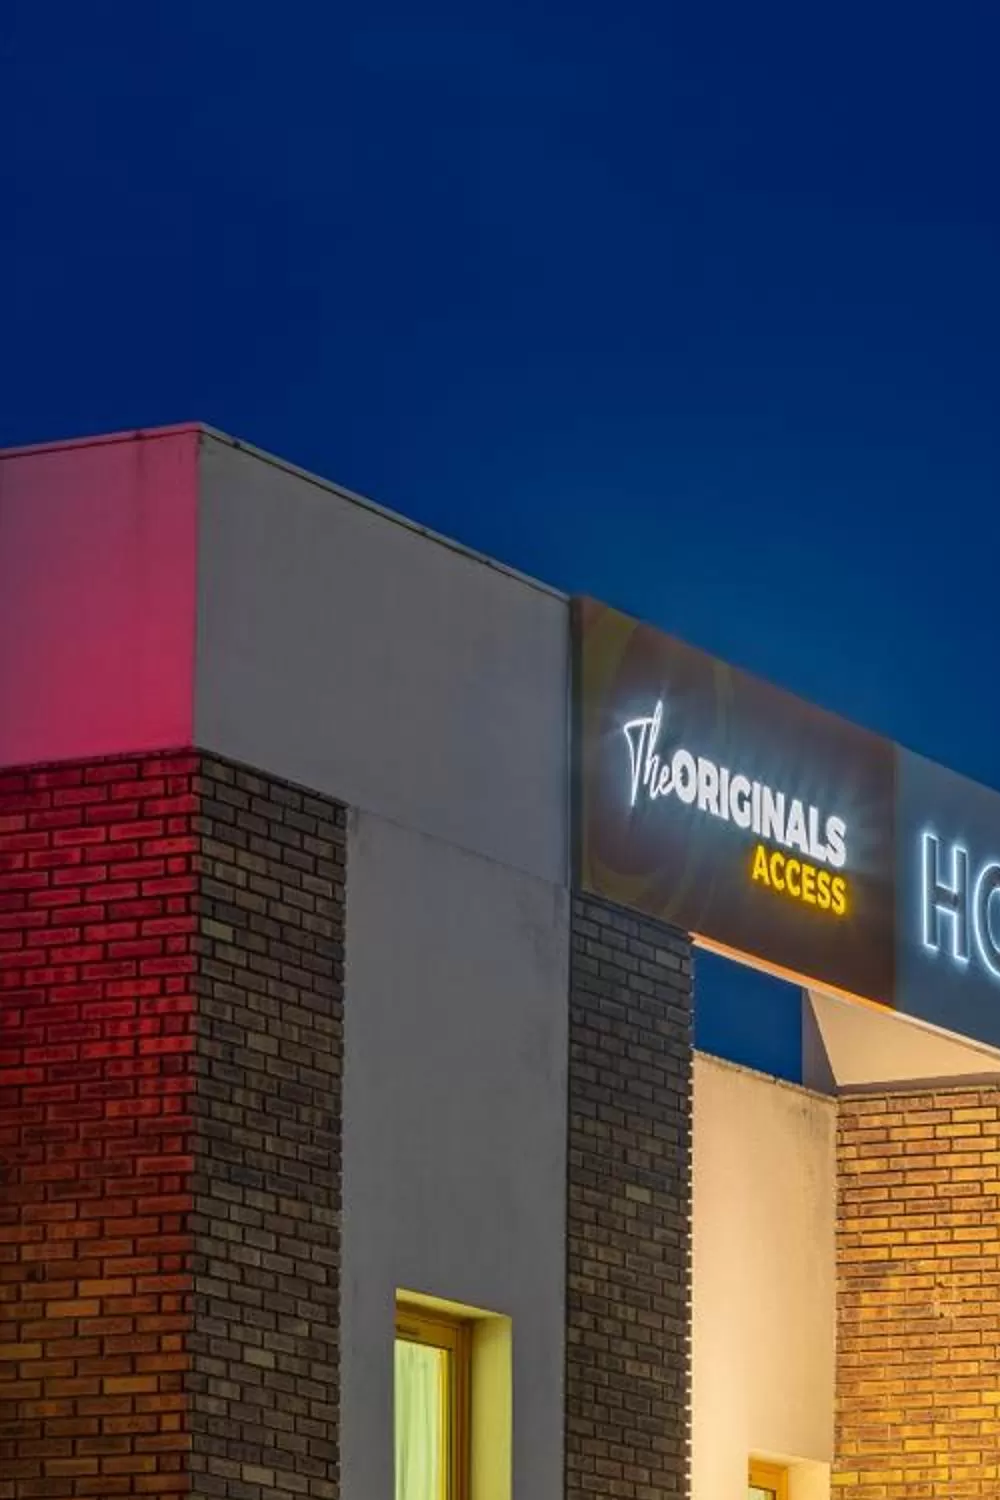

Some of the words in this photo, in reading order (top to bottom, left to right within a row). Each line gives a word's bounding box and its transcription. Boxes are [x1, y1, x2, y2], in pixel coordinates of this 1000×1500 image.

[623, 699, 675, 807] The
[671, 748, 847, 868] ORIGINALS
[751, 844, 847, 917] ACCESS
